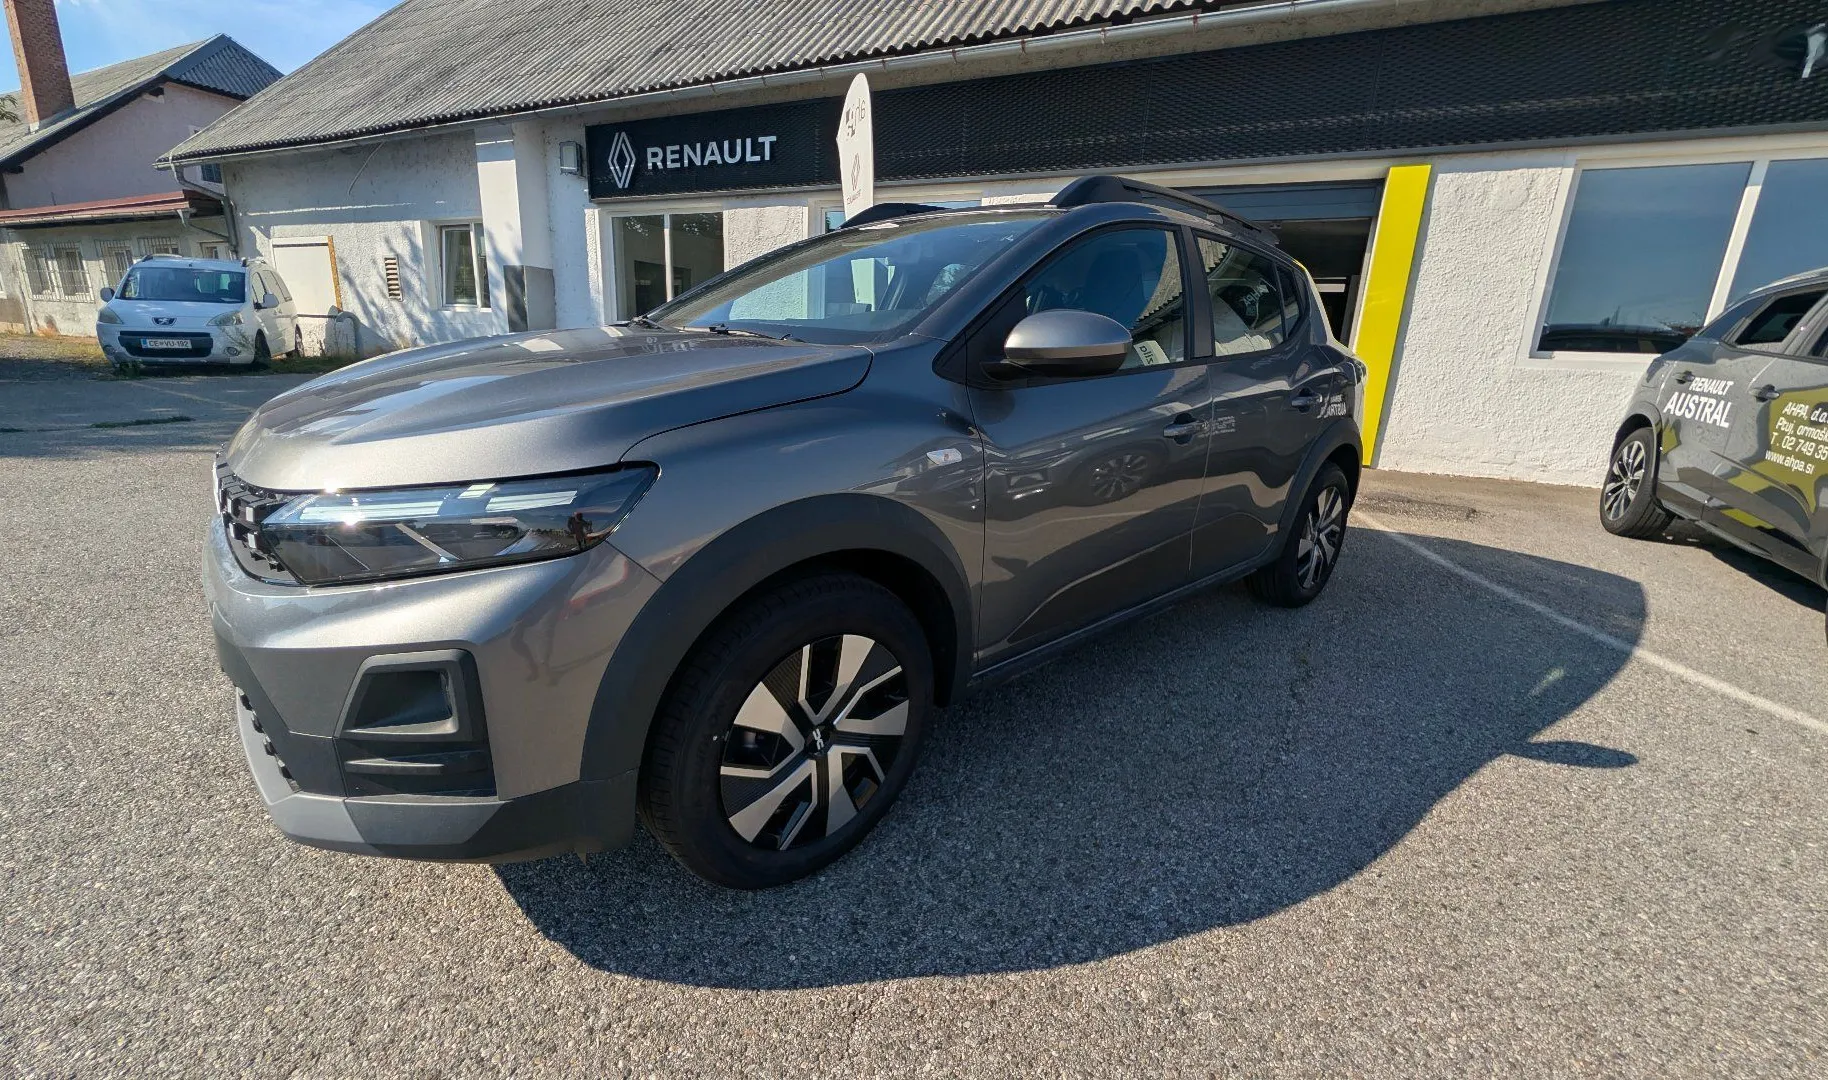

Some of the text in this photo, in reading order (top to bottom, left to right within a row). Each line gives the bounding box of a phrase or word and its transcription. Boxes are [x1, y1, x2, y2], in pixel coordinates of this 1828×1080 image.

[647, 136, 776, 169] RENAULT
[1689, 377, 1734, 396] RENAULT
[1663, 391, 1731, 428] AUSTRAL
[1782, 436, 1796, 450] 02
[1796, 439, 1816, 456] 749
[1765, 450, 1815, 475] www.ahpa.si
